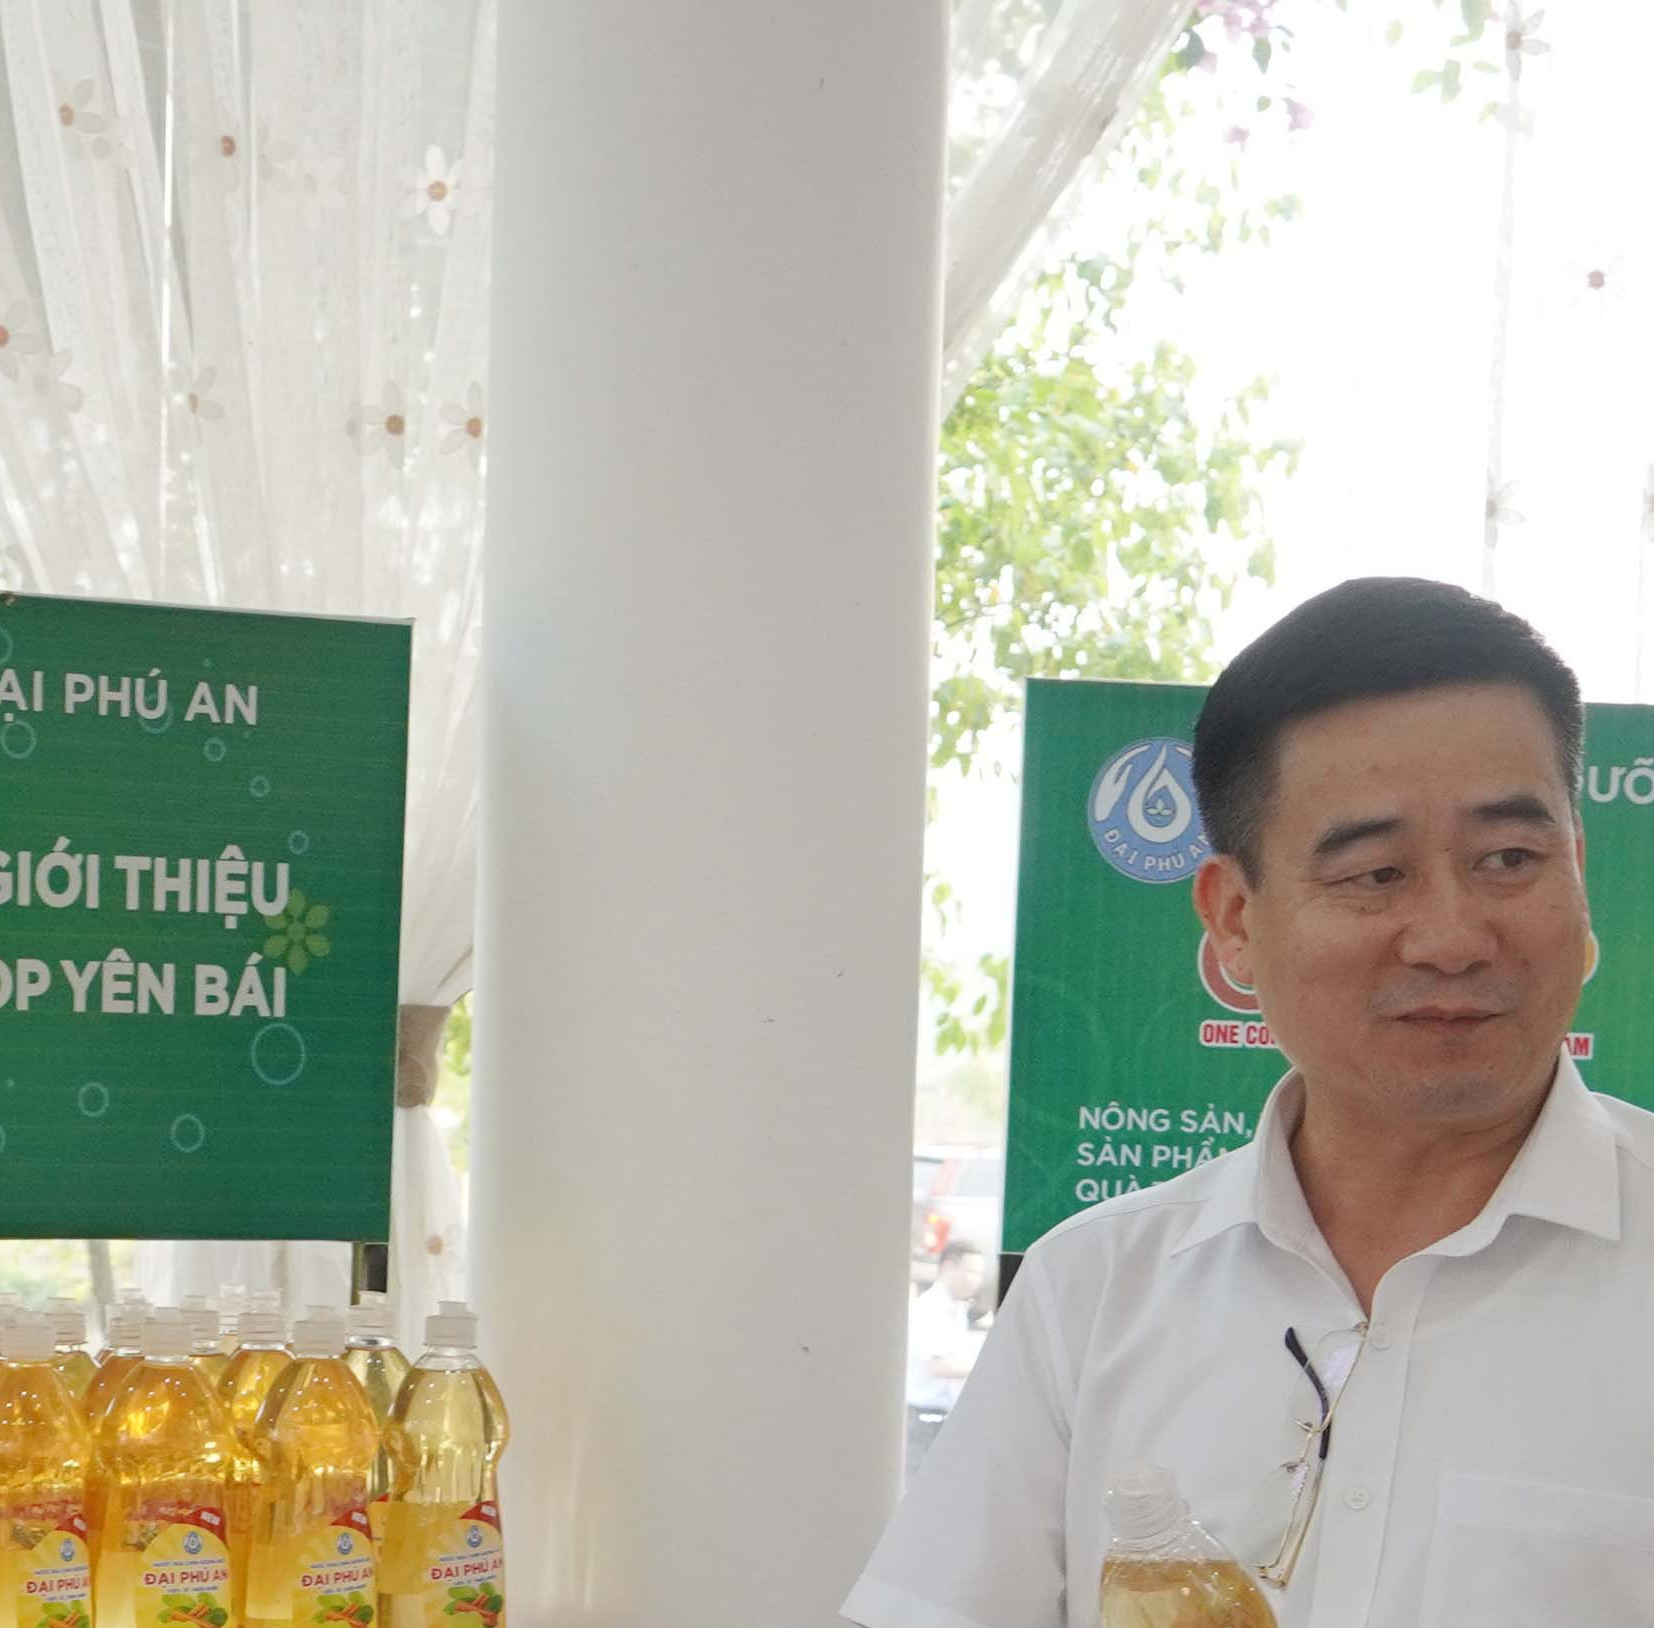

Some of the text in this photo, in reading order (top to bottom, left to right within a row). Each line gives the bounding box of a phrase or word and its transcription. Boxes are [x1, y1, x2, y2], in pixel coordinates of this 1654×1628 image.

[65, 668, 167, 719] PHÚ
[185, 682, 257, 725] AN
[115, 845, 289, 929] THIỆU
[60, 948, 175, 1014] YÊN
[195, 952, 285, 1017] BÁI
[1203, 1023, 1239, 1044] ONE
[1079, 1101, 1171, 1132] NÔNG
[1076, 1136, 1142, 1167] SẢN
